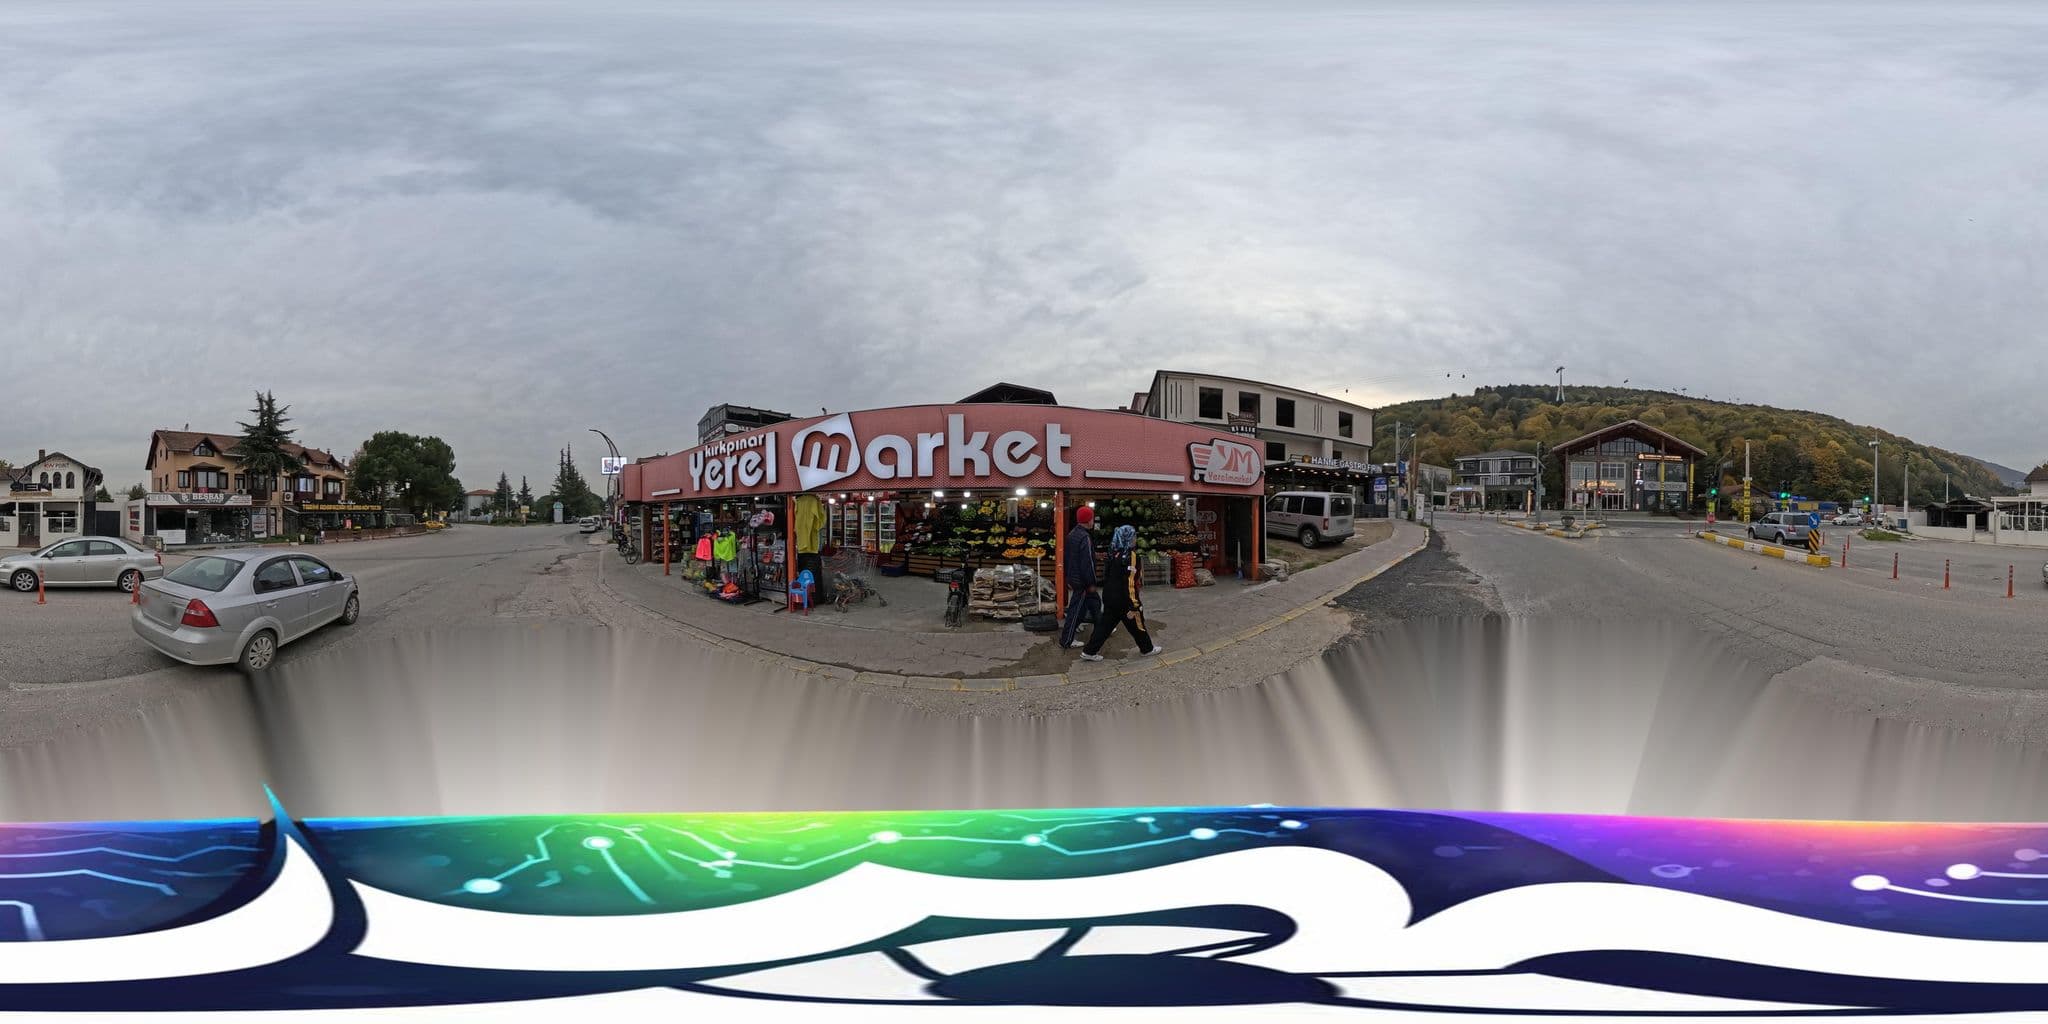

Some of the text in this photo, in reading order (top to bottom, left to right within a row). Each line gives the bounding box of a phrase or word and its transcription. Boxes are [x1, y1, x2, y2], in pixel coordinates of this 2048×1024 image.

[704, 433, 766, 458] kırkpınar
[689, 431, 777, 492] Yerel
[1311, 456, 1340, 467] HANNE
[1340, 461, 1368, 471] GASTRO
